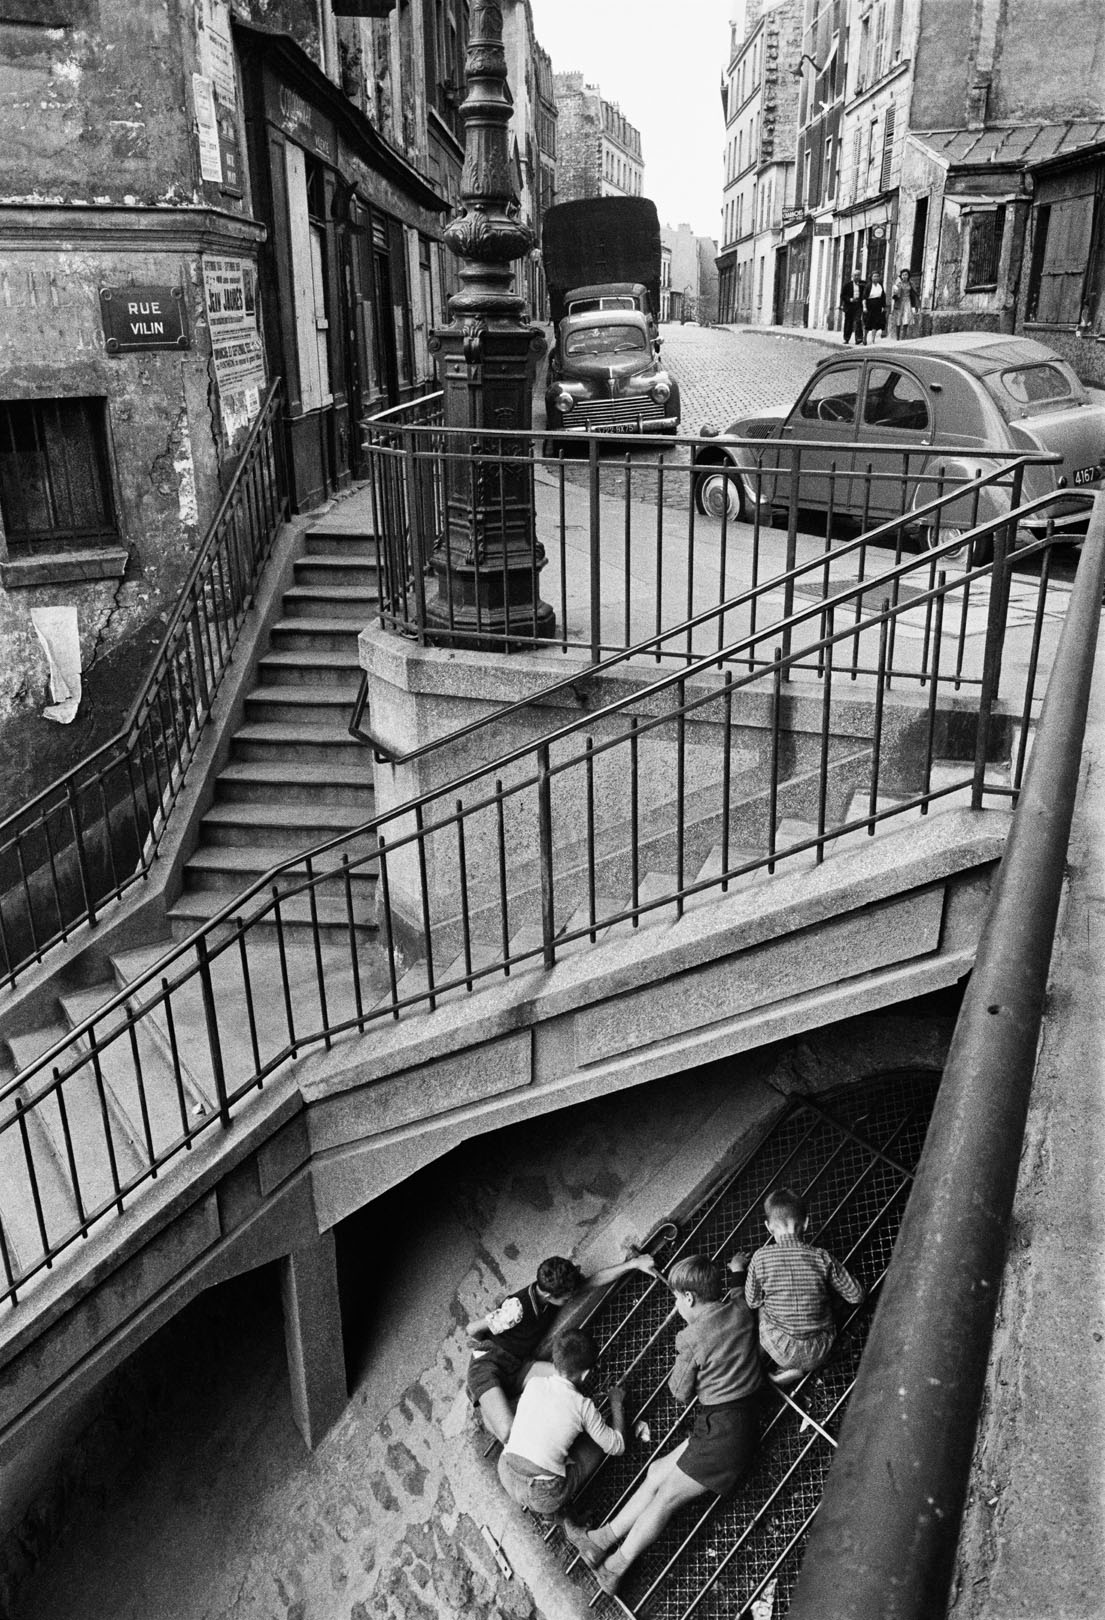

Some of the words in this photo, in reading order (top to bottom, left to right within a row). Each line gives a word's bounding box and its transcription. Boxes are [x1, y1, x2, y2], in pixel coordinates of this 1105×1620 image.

[128, 302, 162, 315] RUE
[130, 322, 164, 335] VILIN
[1075, 467, 1094, 484] 4167
